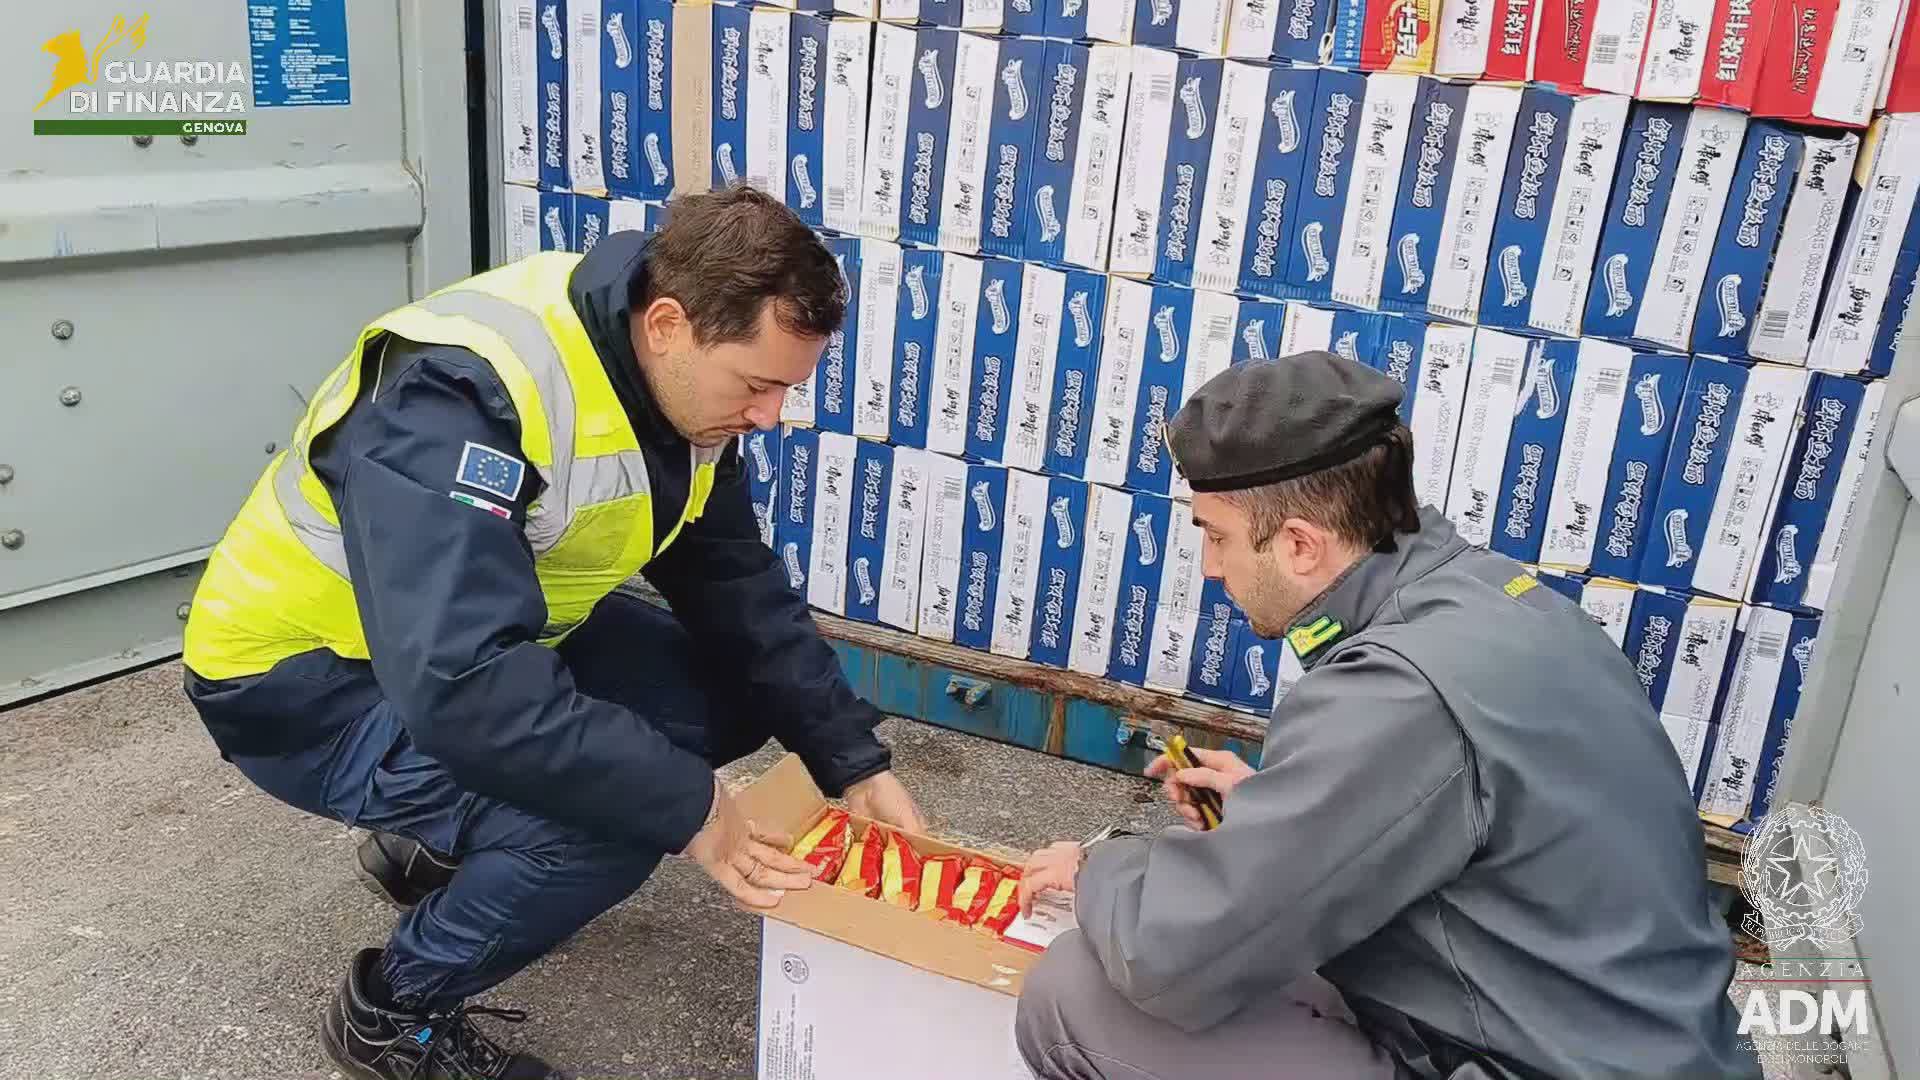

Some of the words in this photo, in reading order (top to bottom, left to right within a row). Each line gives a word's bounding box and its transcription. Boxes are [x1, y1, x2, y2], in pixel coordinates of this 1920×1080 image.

[1793, 398, 1845, 499] 鲜虾鱼板面
